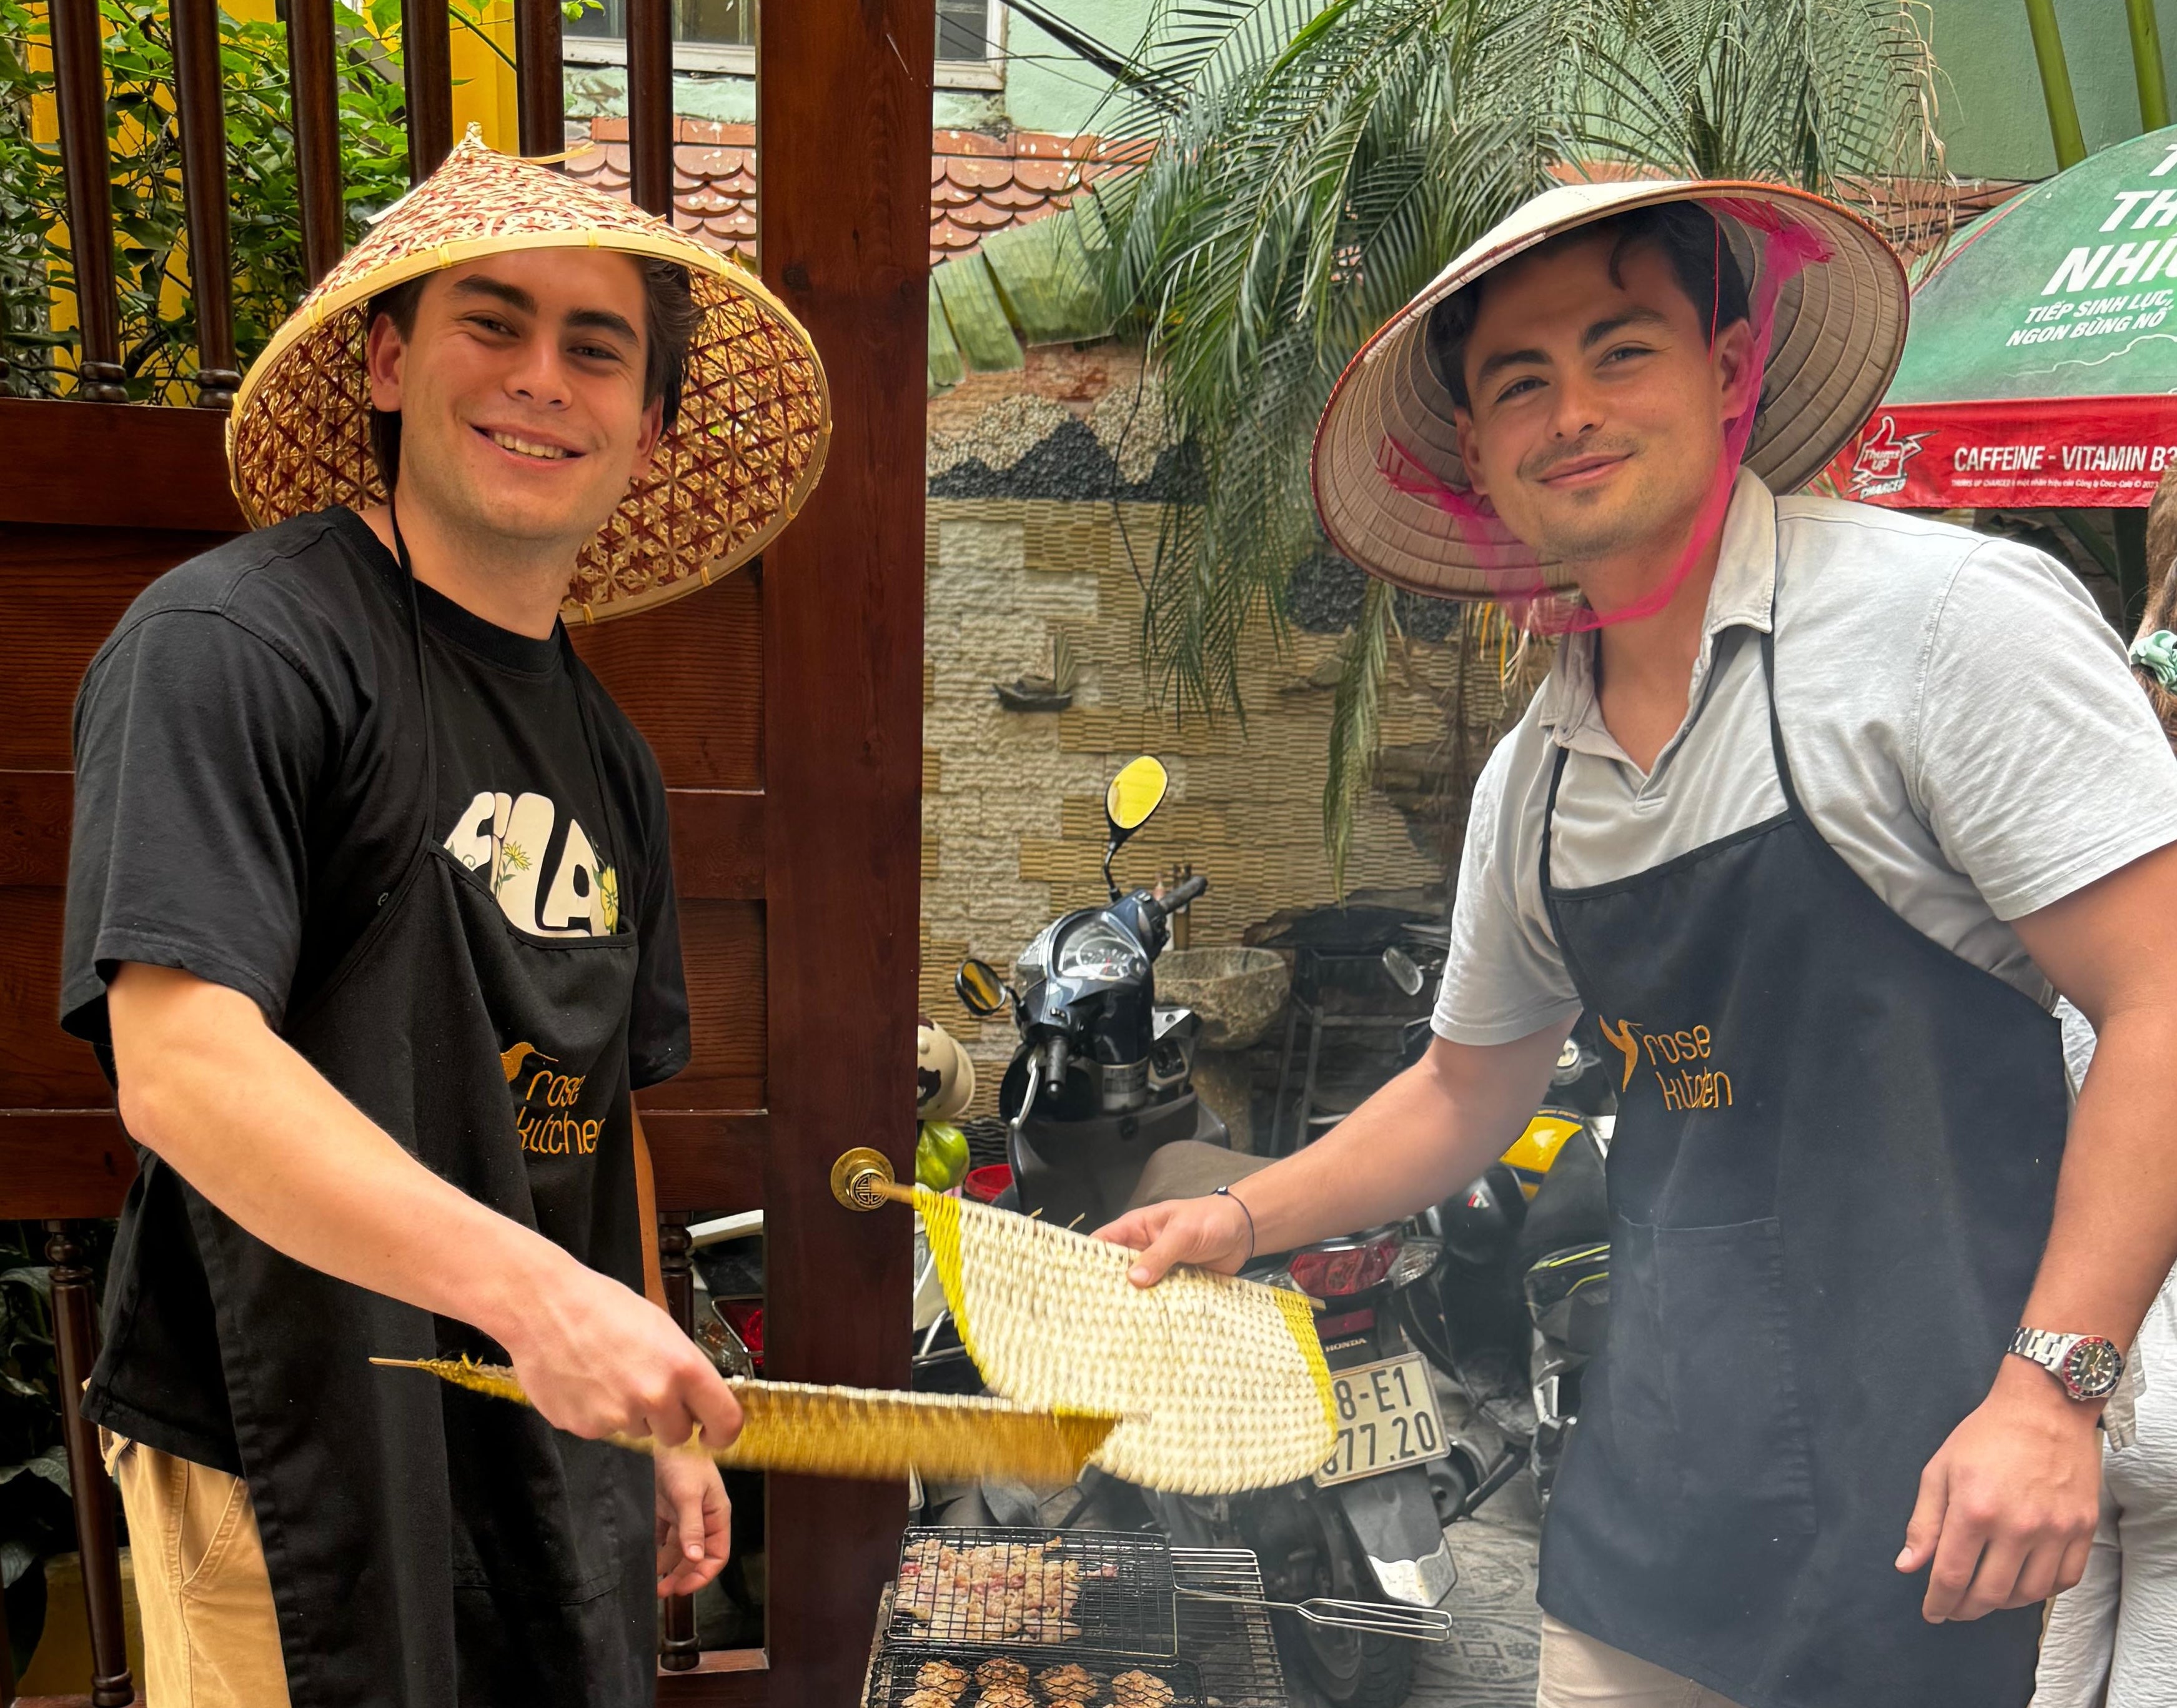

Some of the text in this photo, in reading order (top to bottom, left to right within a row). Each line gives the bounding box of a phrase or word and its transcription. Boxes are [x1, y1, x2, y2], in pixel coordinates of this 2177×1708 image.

[2073, 295, 2130, 317] SINH
[2005, 324, 2072, 347] NGON
[2069, 316, 2134, 339] BÙNG
[1954, 445, 2046, 472] CAFFEINE
[2062, 445, 2148, 471] VITAMIN
[1643, 1025, 1710, 1065] rose
[517, 1106, 606, 1154] kitche
[1325, 1338, 1367, 1353] HONDA
[1334, 1366, 1412, 1421] 8-E1
